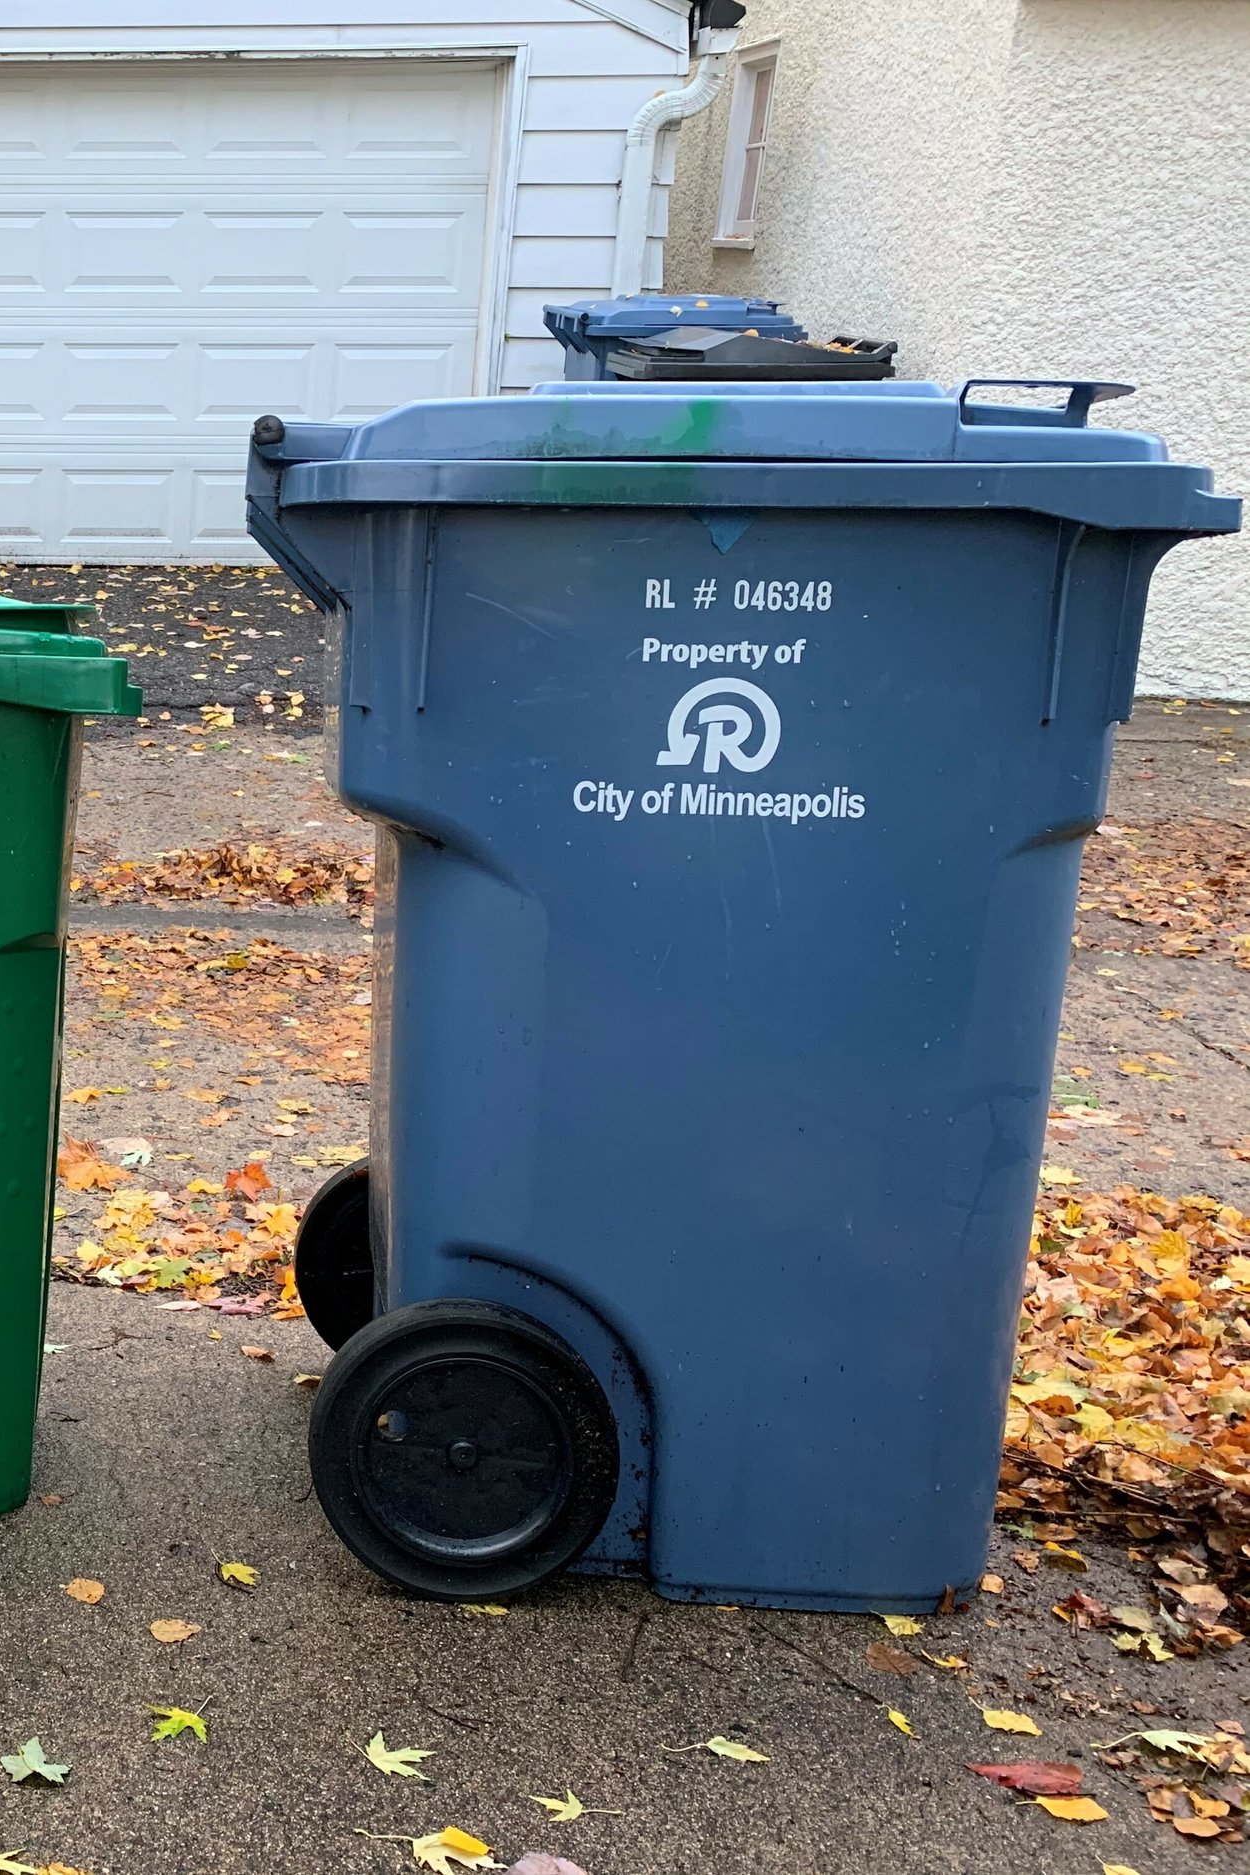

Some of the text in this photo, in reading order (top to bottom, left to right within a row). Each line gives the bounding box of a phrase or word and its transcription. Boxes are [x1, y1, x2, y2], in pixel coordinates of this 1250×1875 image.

[645, 578, 833, 612] RL # 046348
[642, 637, 807, 671] Property of
[573, 780, 866, 825] City of Minneapolis
